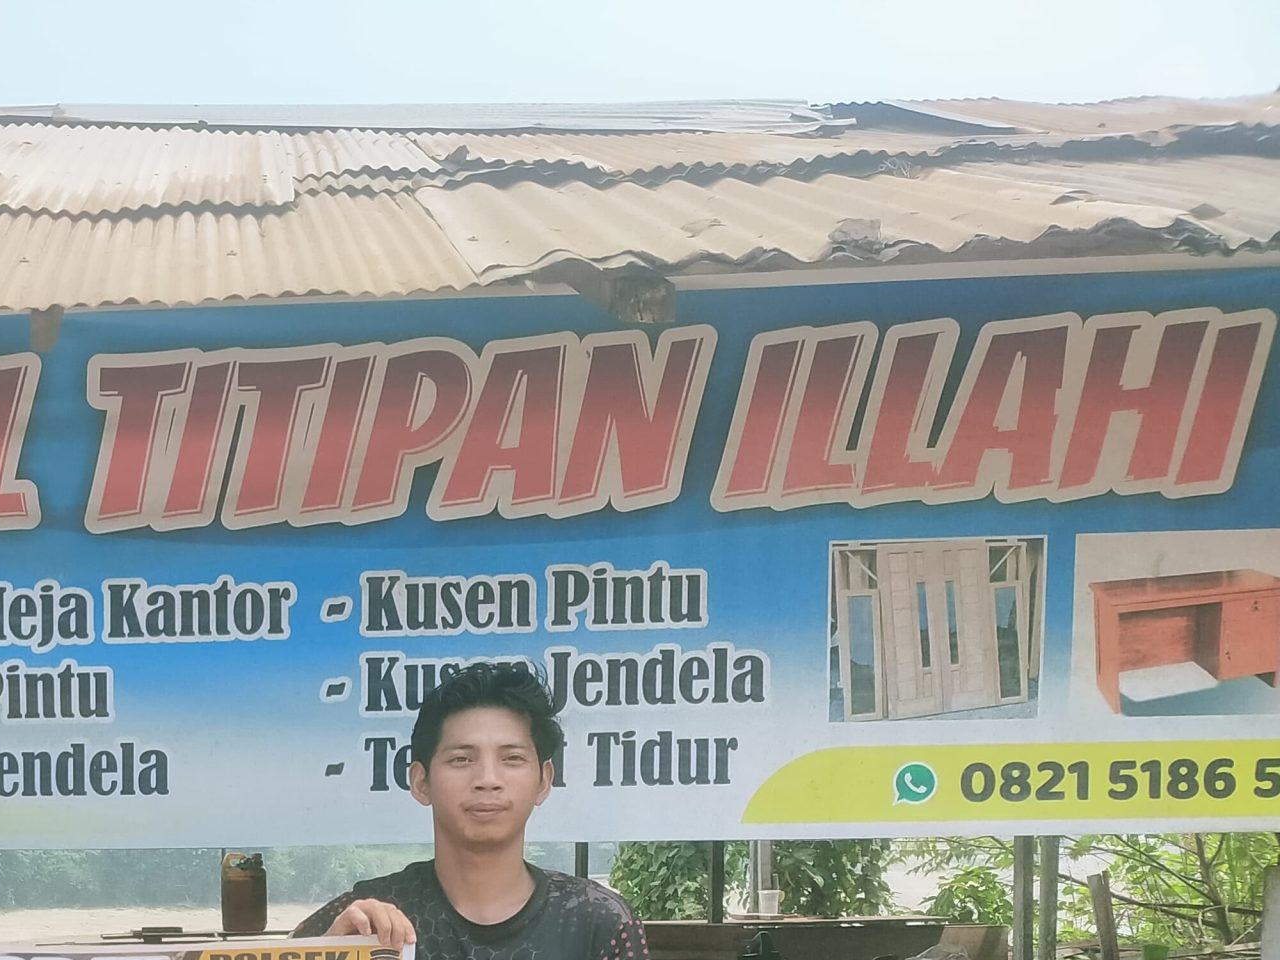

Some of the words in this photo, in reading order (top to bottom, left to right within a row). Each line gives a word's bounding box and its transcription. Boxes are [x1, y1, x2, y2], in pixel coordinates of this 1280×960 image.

[88, 328, 714, 530] TITIPAN
[713, 310, 1273, 509] ILLAHI
[107, 580, 292, 639] Kantor
[365, 575, 532, 632] Kusen
[551, 567, 703, 627] Pintu
[549, 647, 765, 714] Jendela
[587, 730, 739, 787] Tidur
[960, 760, 1090, 803] 0821
[1107, 758, 1237, 800] 5186
